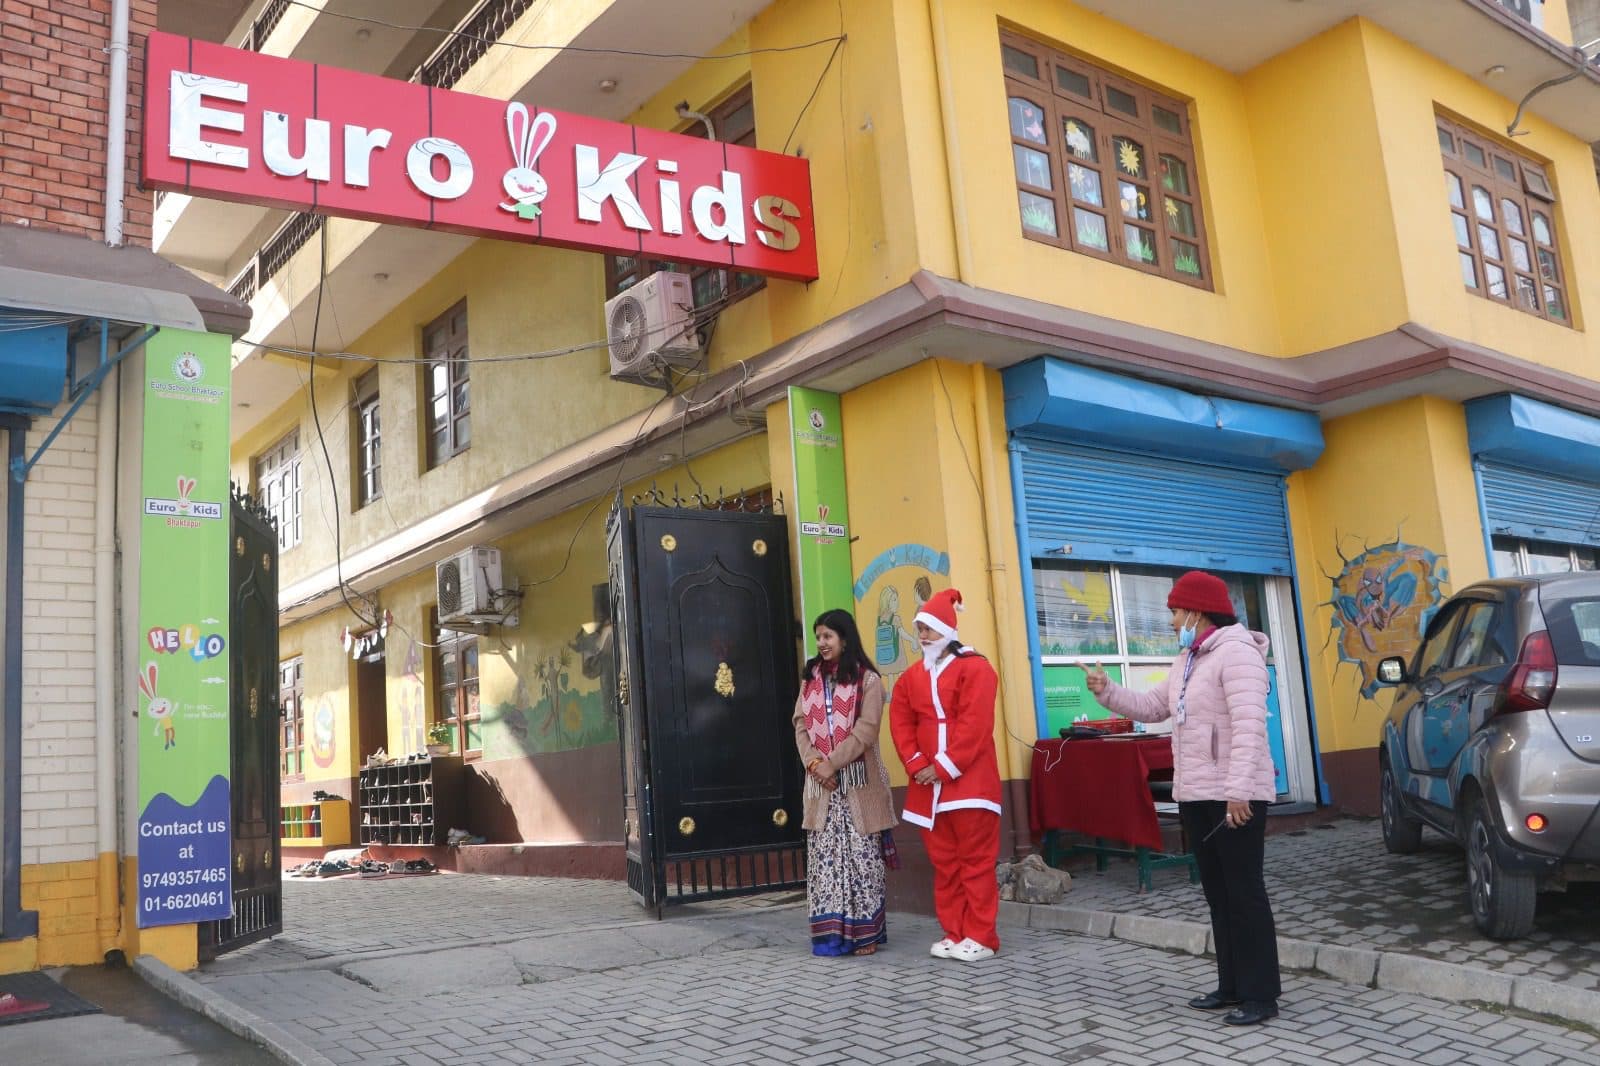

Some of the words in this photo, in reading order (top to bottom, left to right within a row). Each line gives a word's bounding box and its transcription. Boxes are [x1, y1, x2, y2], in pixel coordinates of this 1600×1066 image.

[169, 70, 474, 199] Euro
[575, 143, 801, 252] Kids
[149, 501, 176, 512] Euro
[193, 505, 218, 515] Kids
[803, 524, 819, 532] Euro
[828, 527, 843, 535] Kids
[150, 627, 221, 656] HELLO
[140, 819, 204, 837] Contact
[207, 820, 226, 833] us
[178, 844, 194, 859] at
[143, 867, 226, 888] 9749357465
[144, 890, 223, 912] 01-6620461
